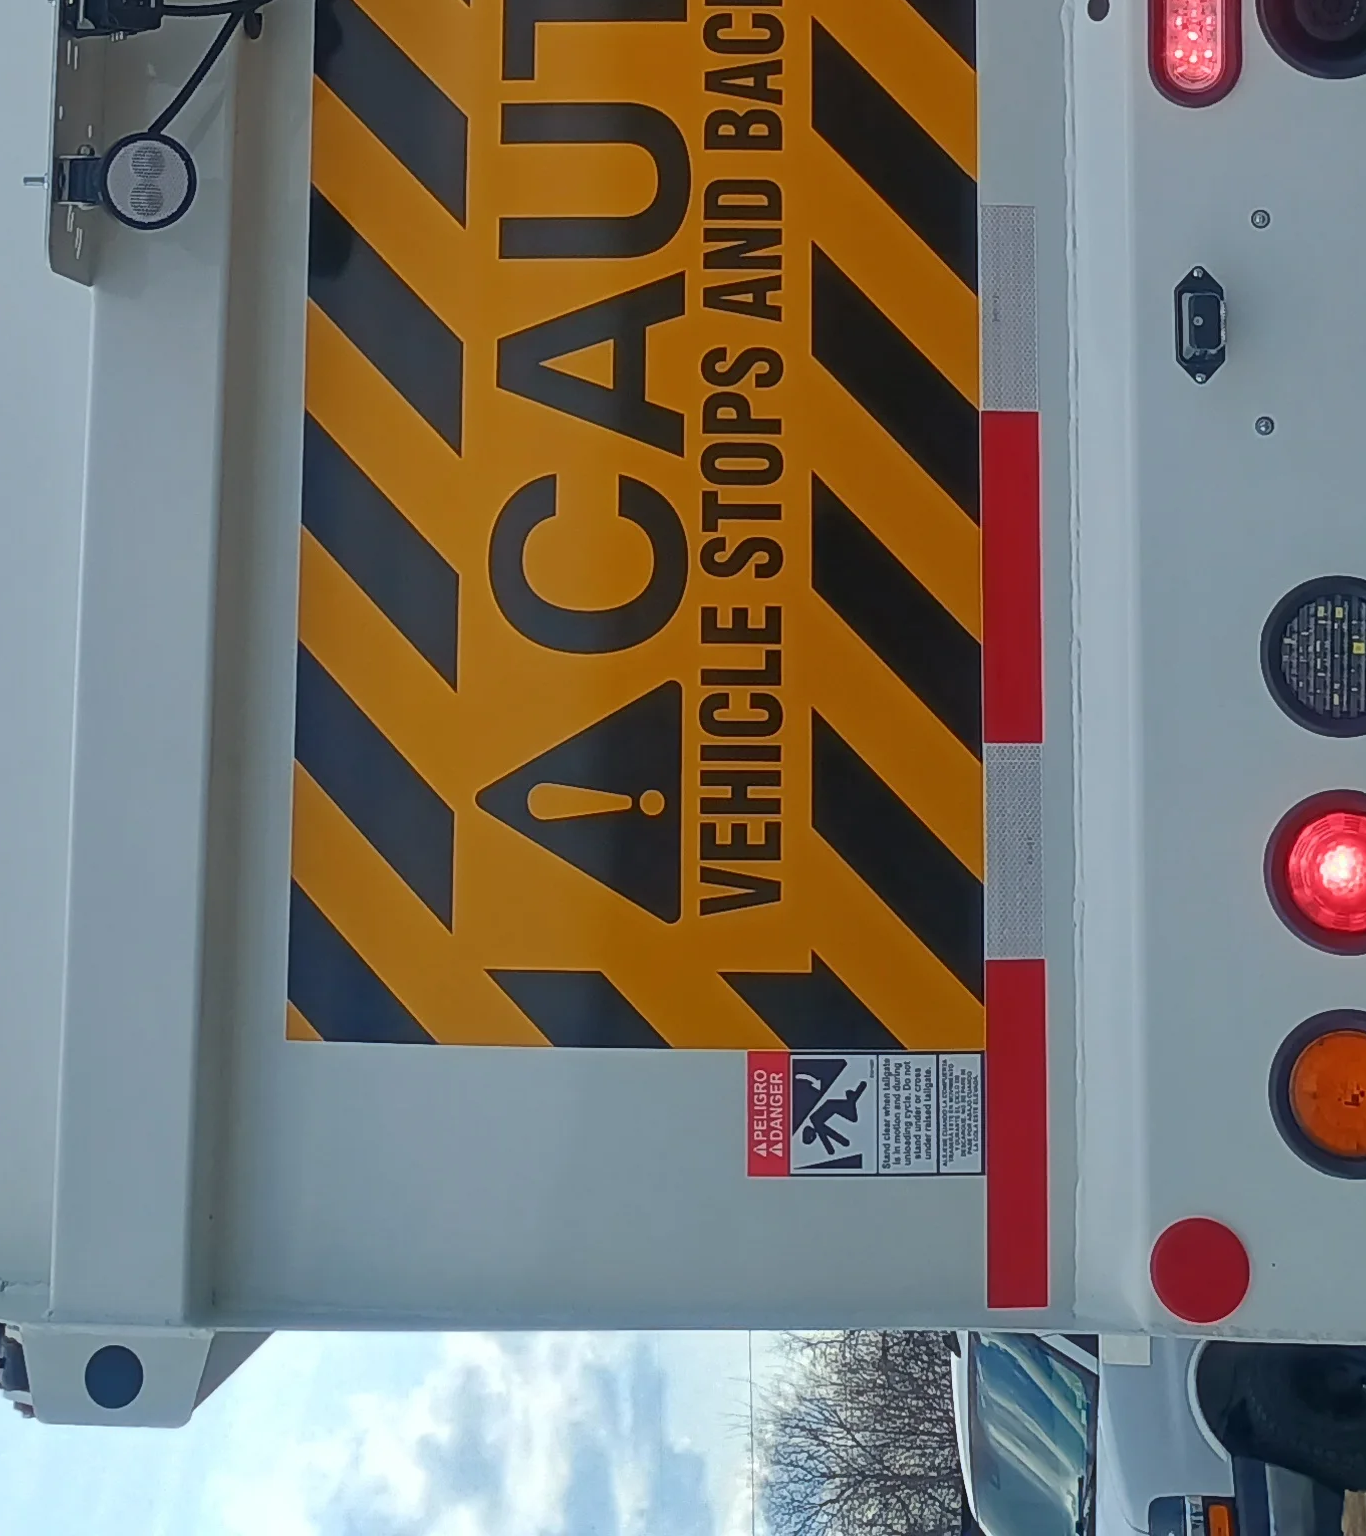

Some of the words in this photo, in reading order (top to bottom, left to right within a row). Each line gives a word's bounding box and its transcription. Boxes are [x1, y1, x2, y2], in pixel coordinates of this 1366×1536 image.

[699, 178, 783, 323] AND
[699, 346, 783, 580] STOPS
[699, 604, 783, 916] VEHICLE
[881, 1058, 893, 1091] tailgate
[892, 1063, 902, 1092] during
[903, 1061, 912, 1076] not
[914, 1067, 922, 1093] cross
[903, 1078, 912, 1091] Do
[923, 1067, 933, 1102] tailgate.
[753, 1069, 767, 1141] PELIGRO
[769, 1072, 783, 1141] DANGER
[881, 1093, 891, 1117] when
[892, 1094, 901, 1110] and
[903, 1093, 912, 1118] cycle.
[915, 1095, 922, 1104] or
[881, 1119, 891, 1141] clear
[892, 1112, 901, 1144] motion
[913, 1106, 922, 1132] under
[923, 1104, 932, 1132] raised
[881, 1143, 891, 1169] Stand
[892, 1146, 901, 1155] in
[903, 1121, 912, 1166] unloading
[913, 1134, 922, 1159] stand
[923, 1133, 932, 1160] under
[892, 1157, 901, 1165] is
